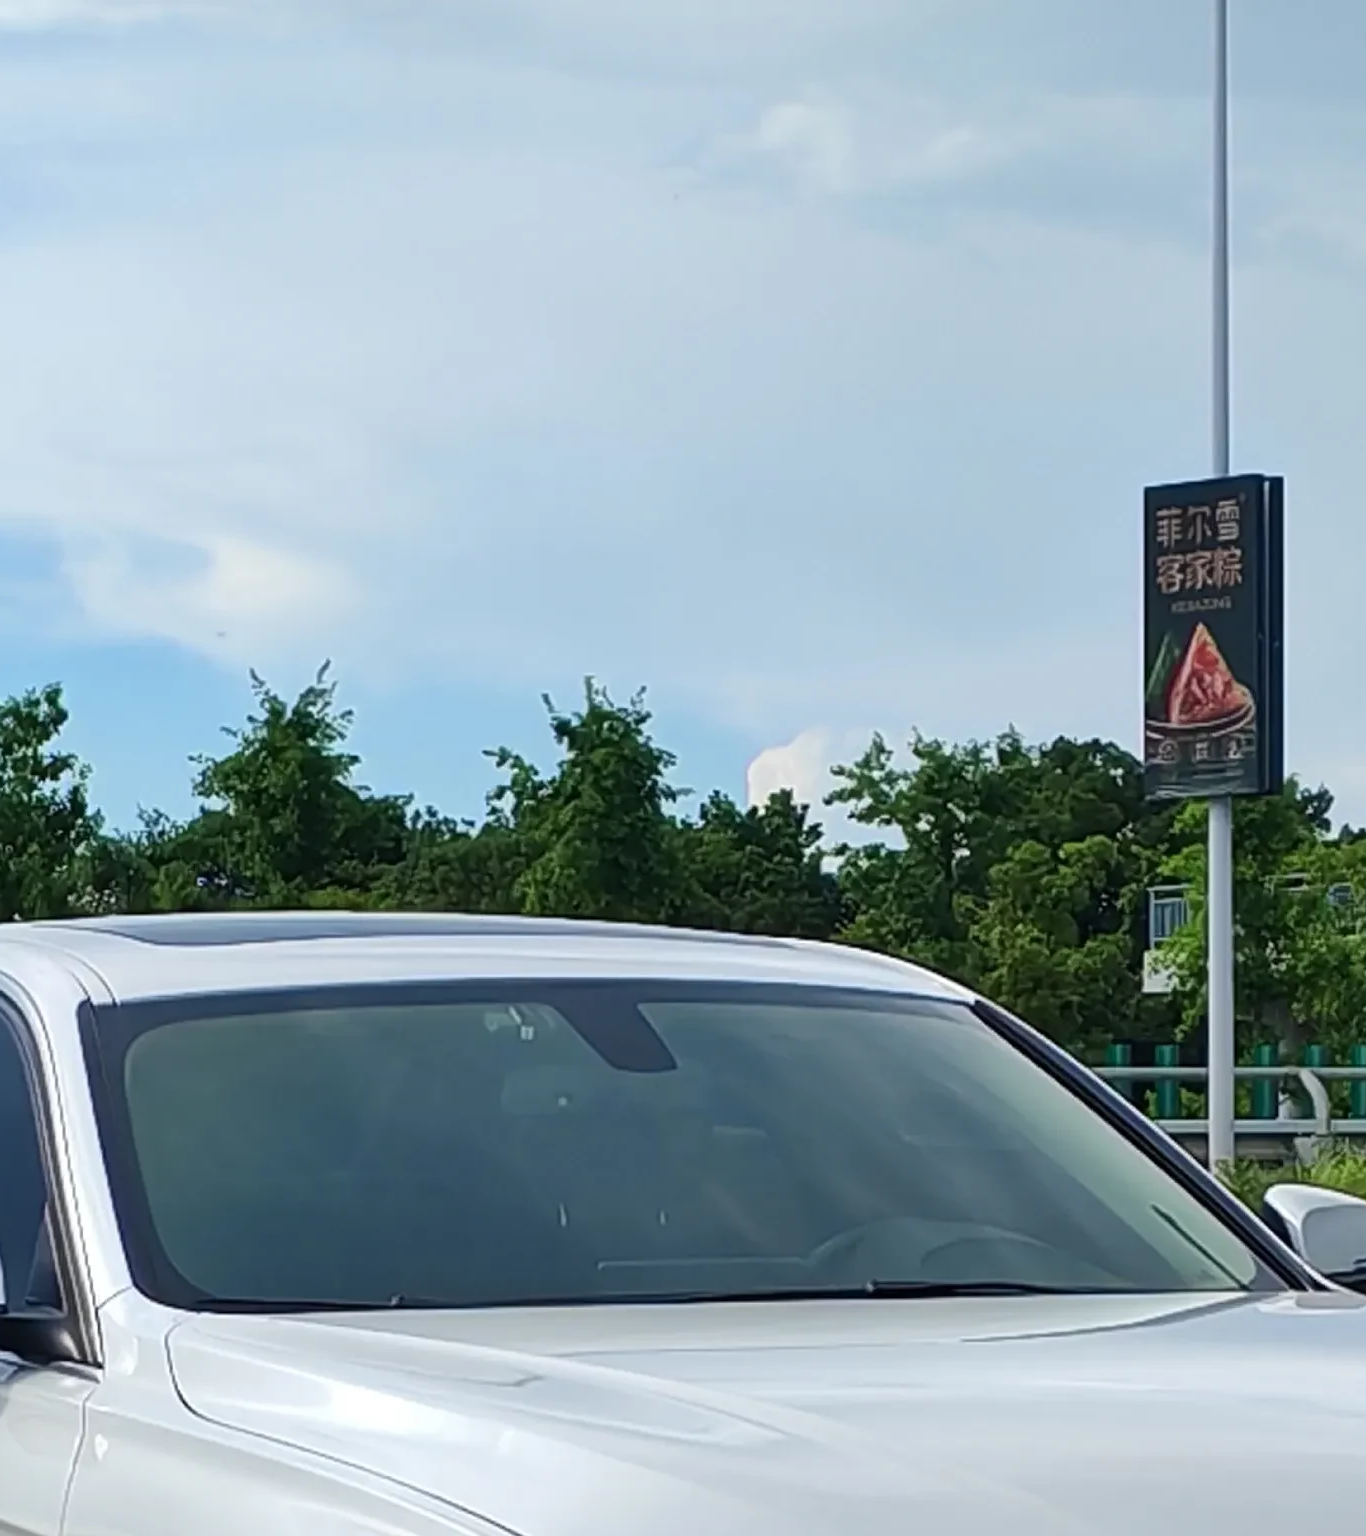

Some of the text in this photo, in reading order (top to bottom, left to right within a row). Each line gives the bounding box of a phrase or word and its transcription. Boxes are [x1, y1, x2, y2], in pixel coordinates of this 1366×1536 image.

[1155, 499, 1240, 549] 菲尔雪
[1155, 545, 1243, 594] 客家粽
